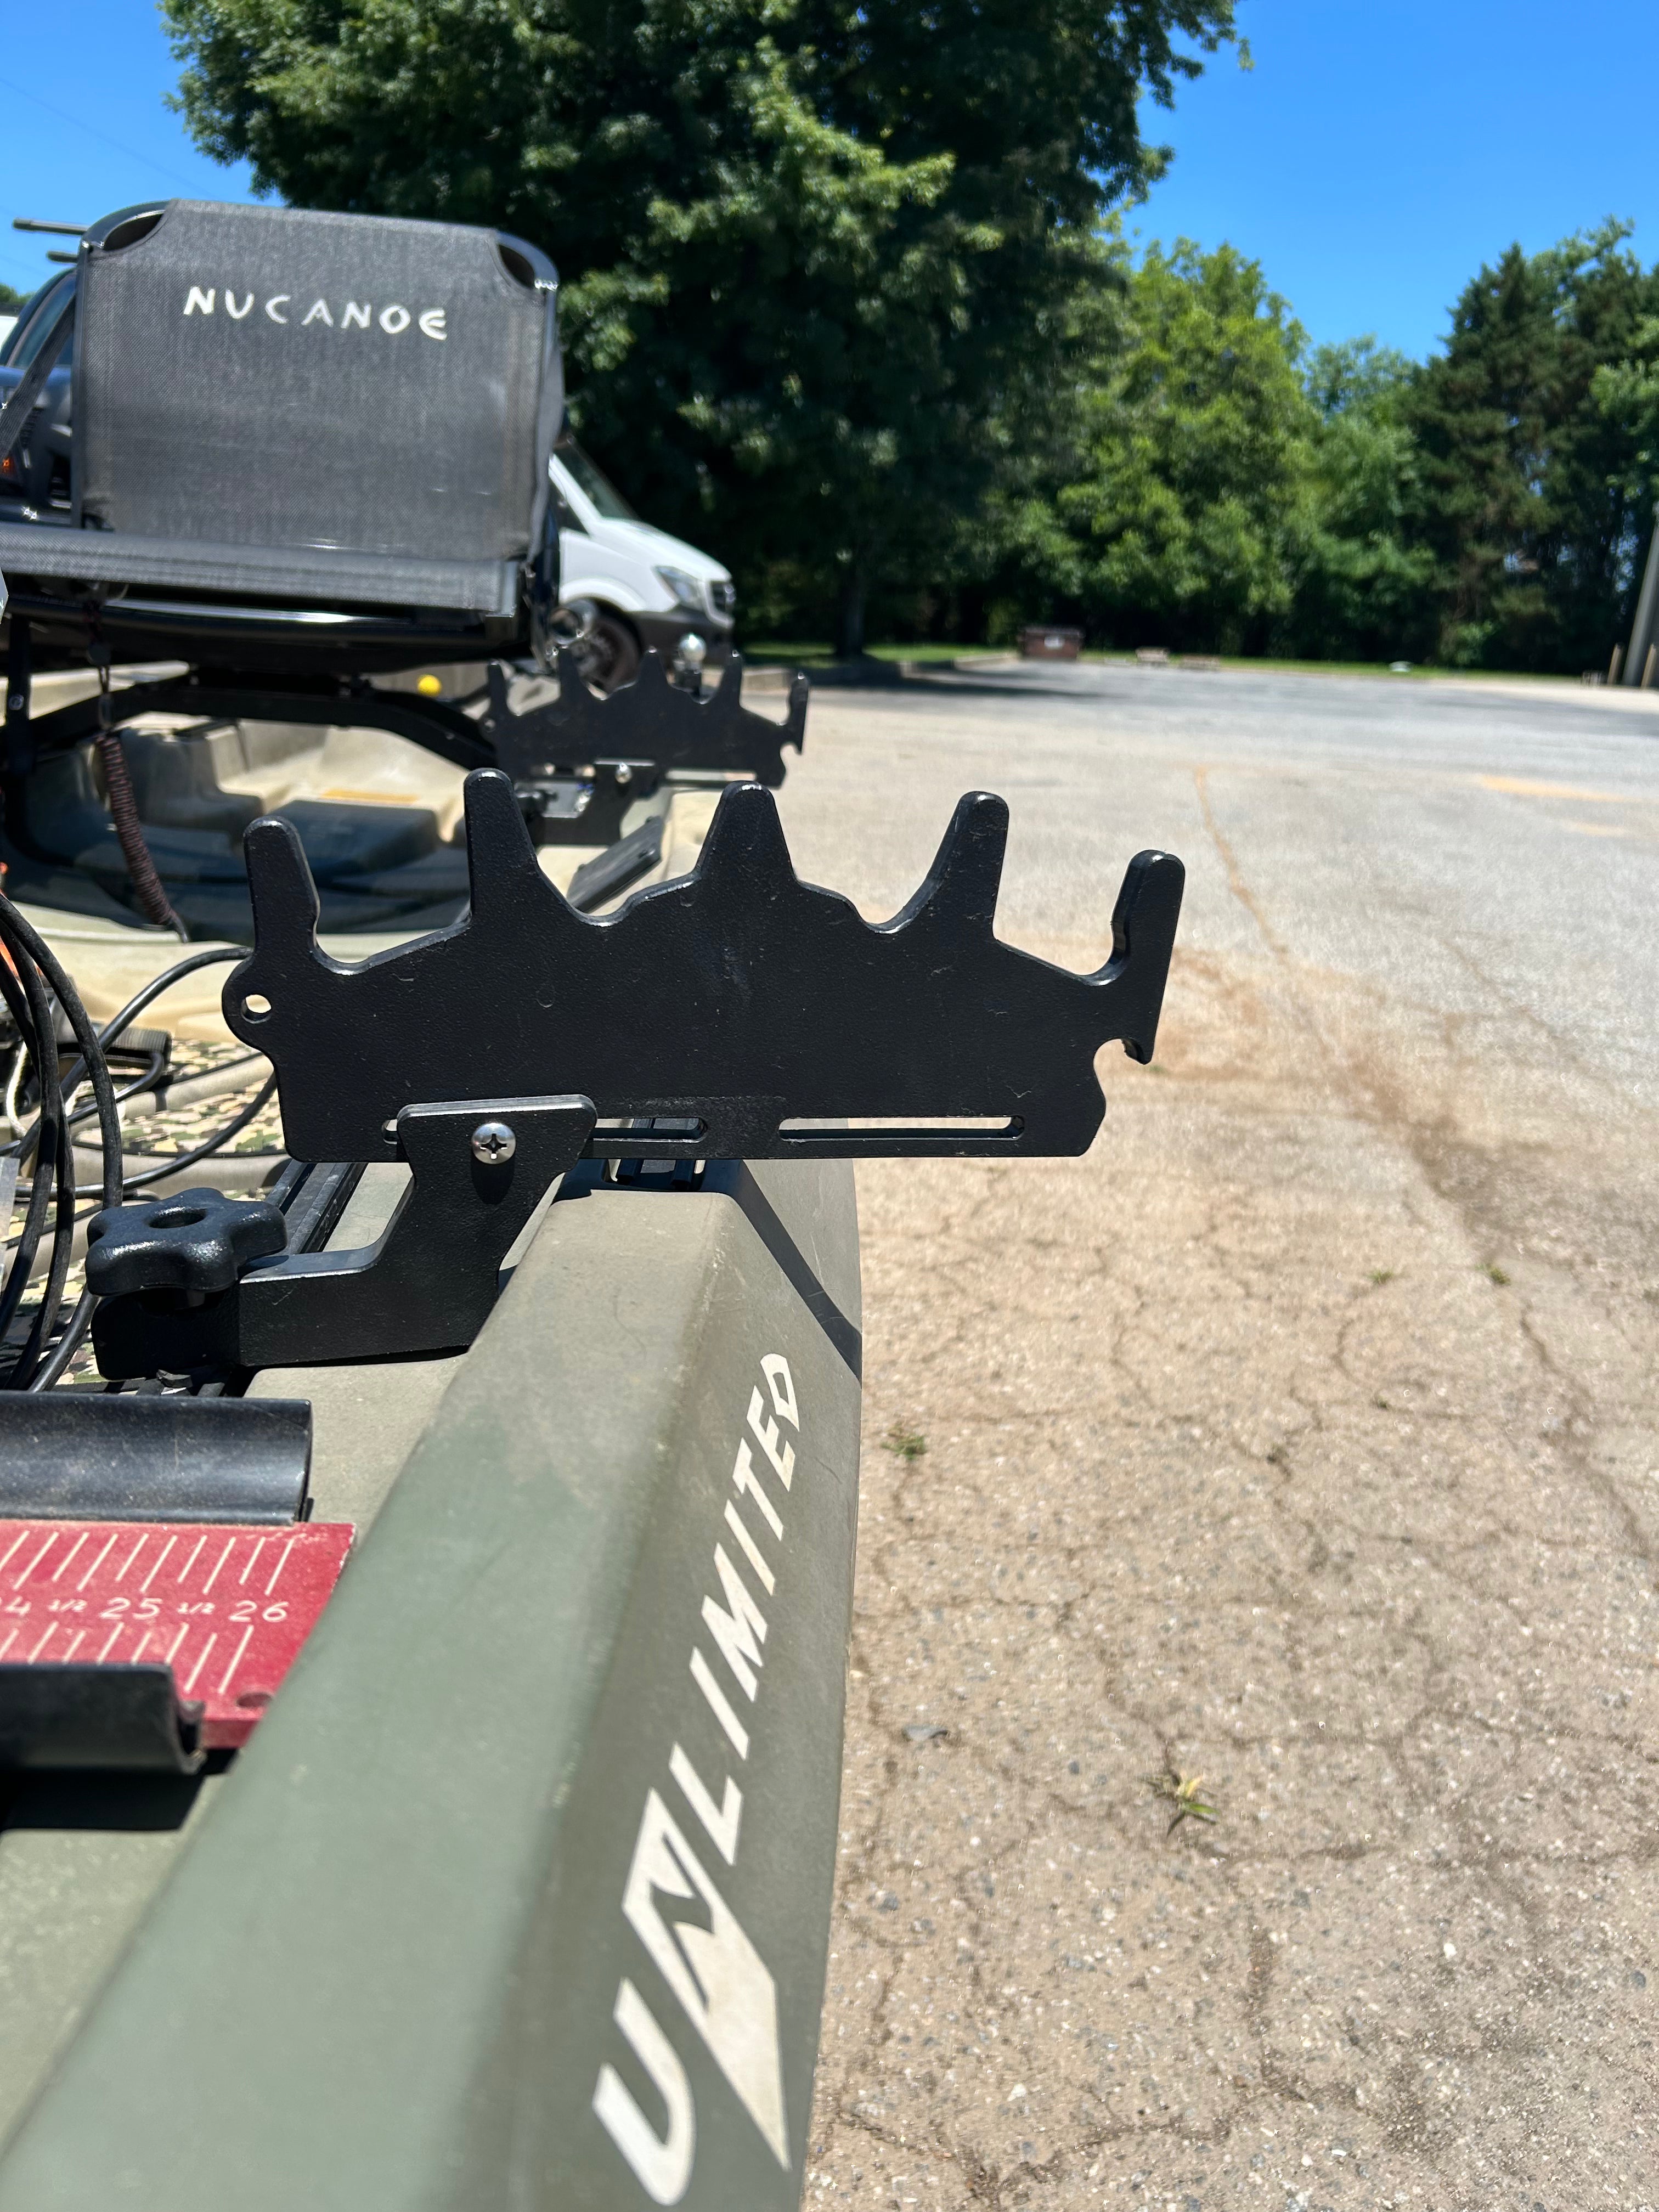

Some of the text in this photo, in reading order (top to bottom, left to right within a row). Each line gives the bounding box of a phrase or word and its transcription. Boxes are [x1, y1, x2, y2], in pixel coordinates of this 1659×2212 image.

[183, 286, 448, 341] NUCANOE
[0, 1596, 290, 1622] 4 1/2 25 1/2 26
[591, 1353, 799, 2207] UNLIMITED
